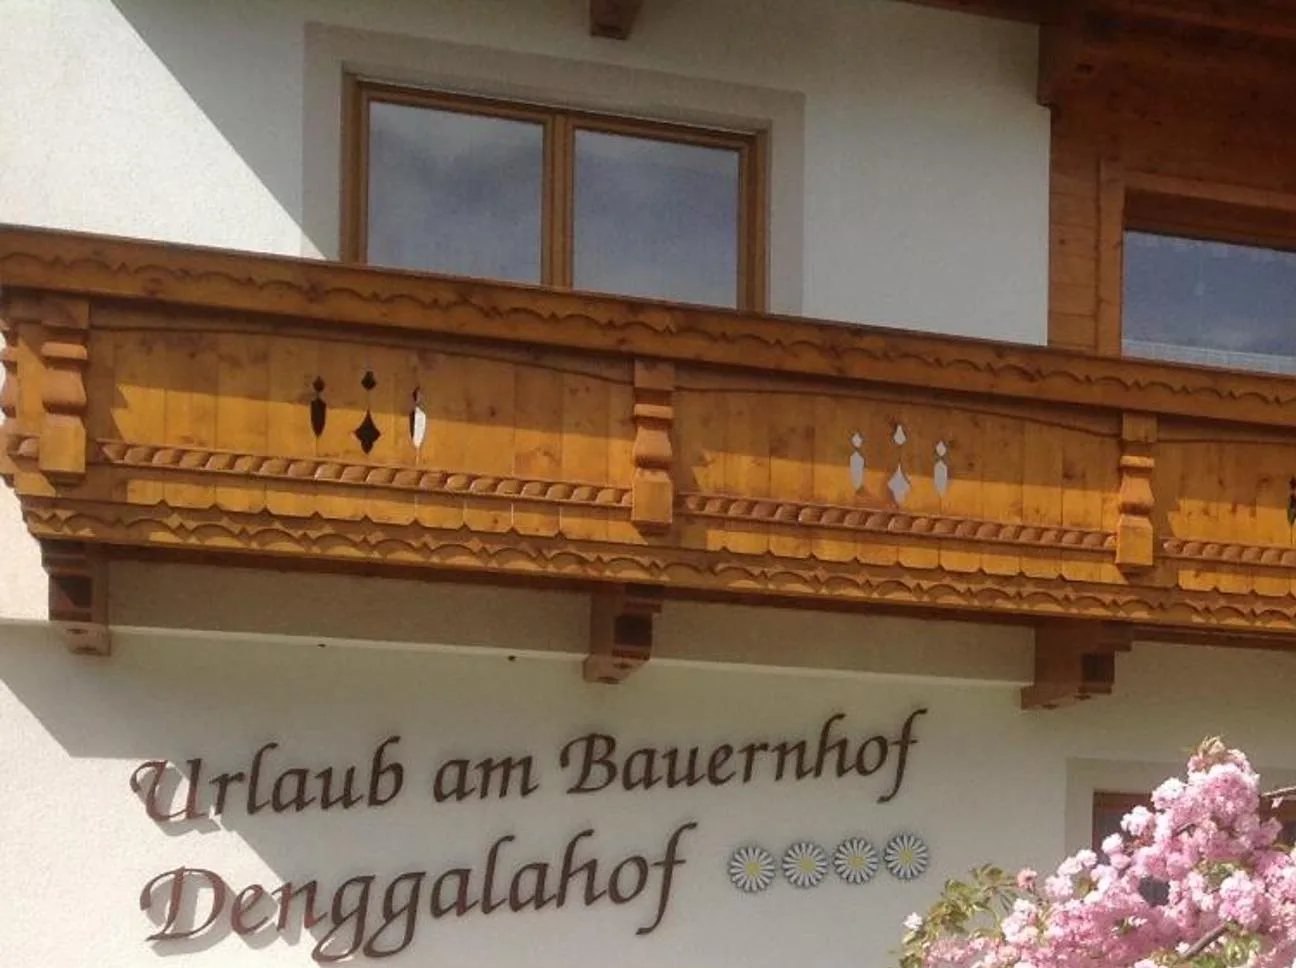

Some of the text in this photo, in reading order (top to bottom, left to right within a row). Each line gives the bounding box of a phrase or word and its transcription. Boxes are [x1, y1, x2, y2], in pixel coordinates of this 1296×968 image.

[130, 708, 928, 822] Urlaub am Bauernhof
[140, 821, 697, 963] Denggalahof
